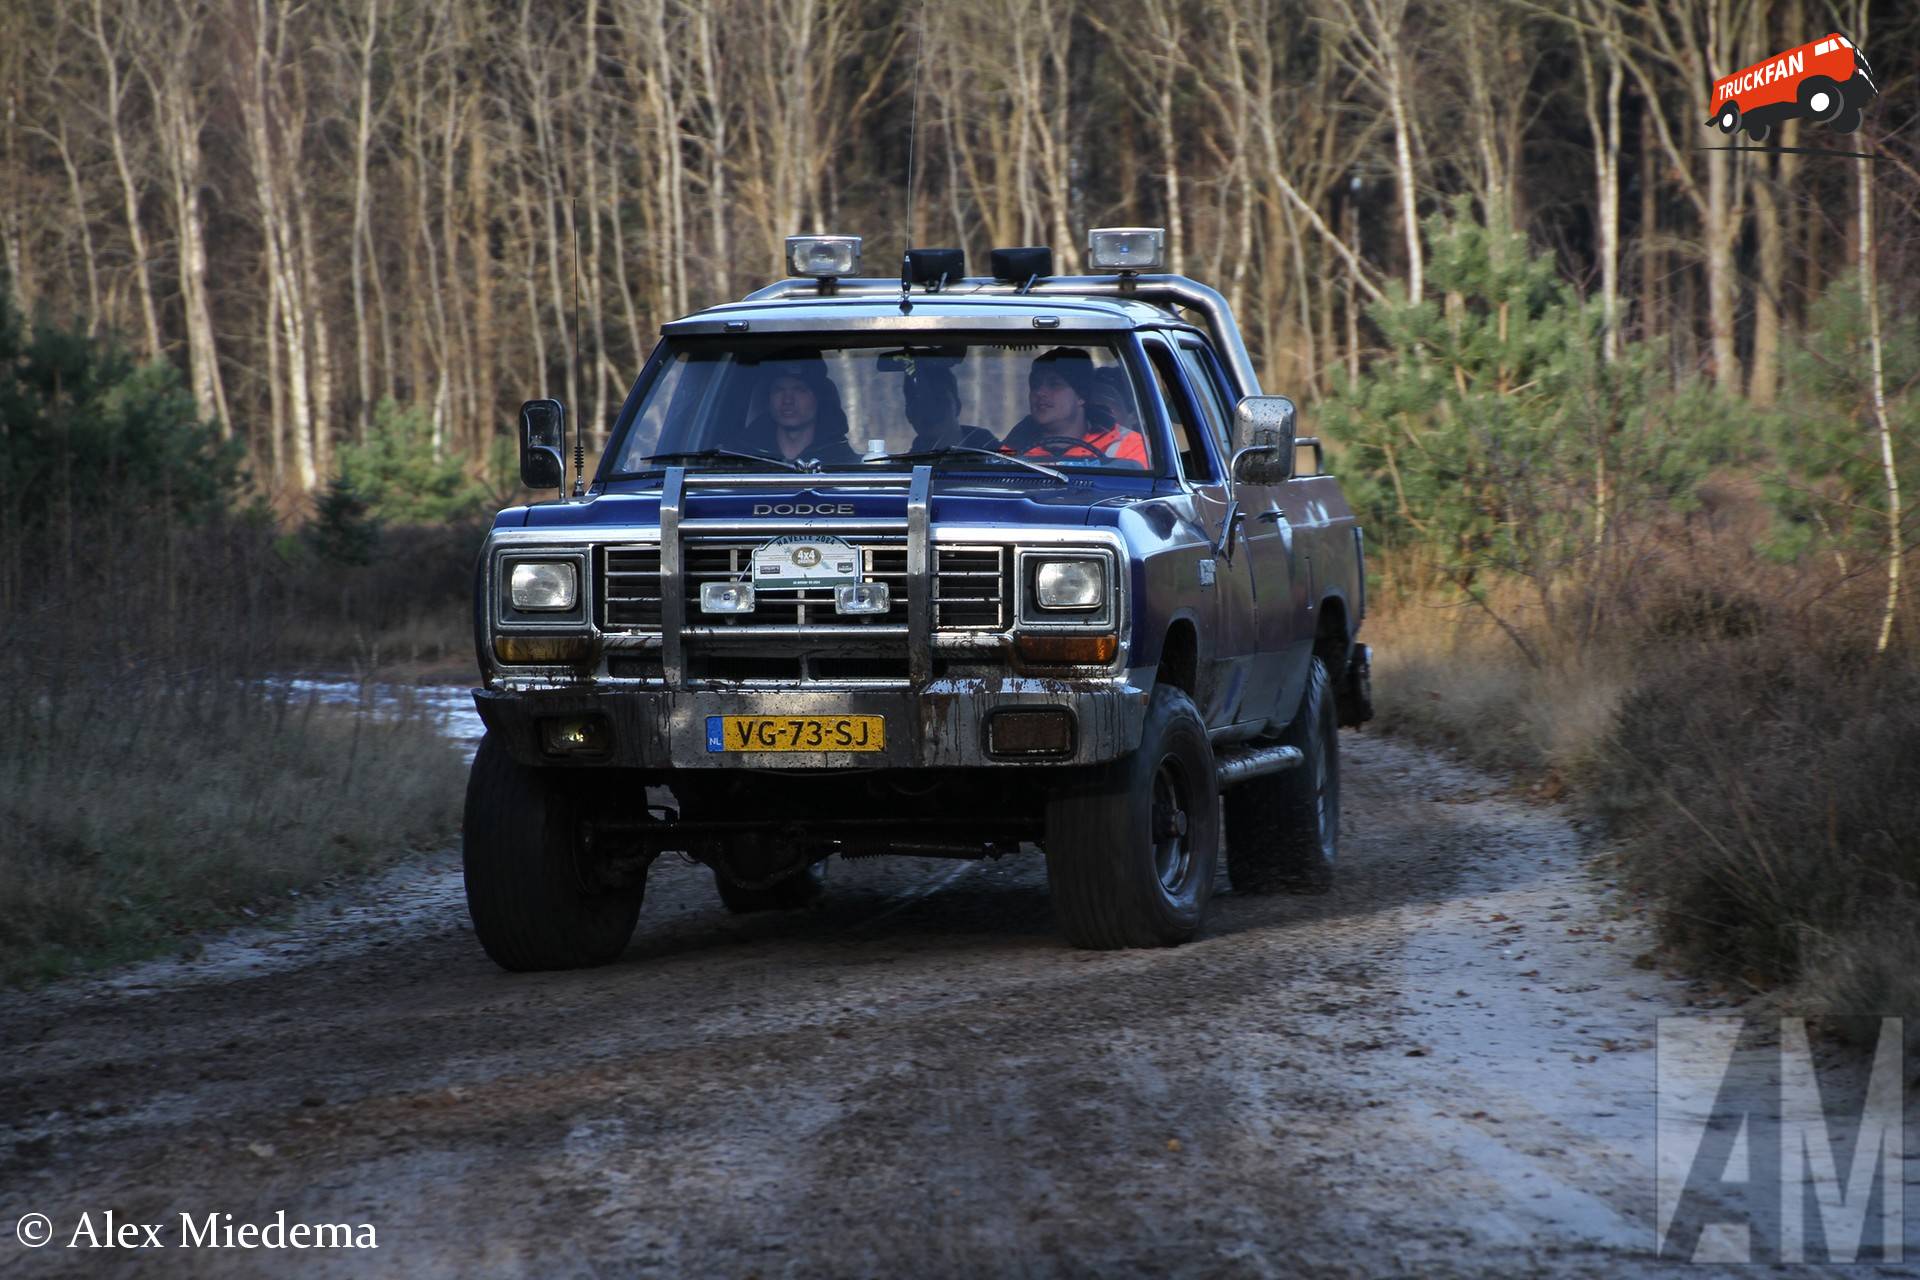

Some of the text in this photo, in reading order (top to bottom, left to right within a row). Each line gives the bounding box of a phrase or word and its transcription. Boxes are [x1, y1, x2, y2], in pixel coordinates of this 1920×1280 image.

[753, 503, 854, 515] DODGE
[797, 549, 816, 560] 4x4
[737, 720, 869, 747] VG-73-SJ
[709, 737, 722, 746] NL
